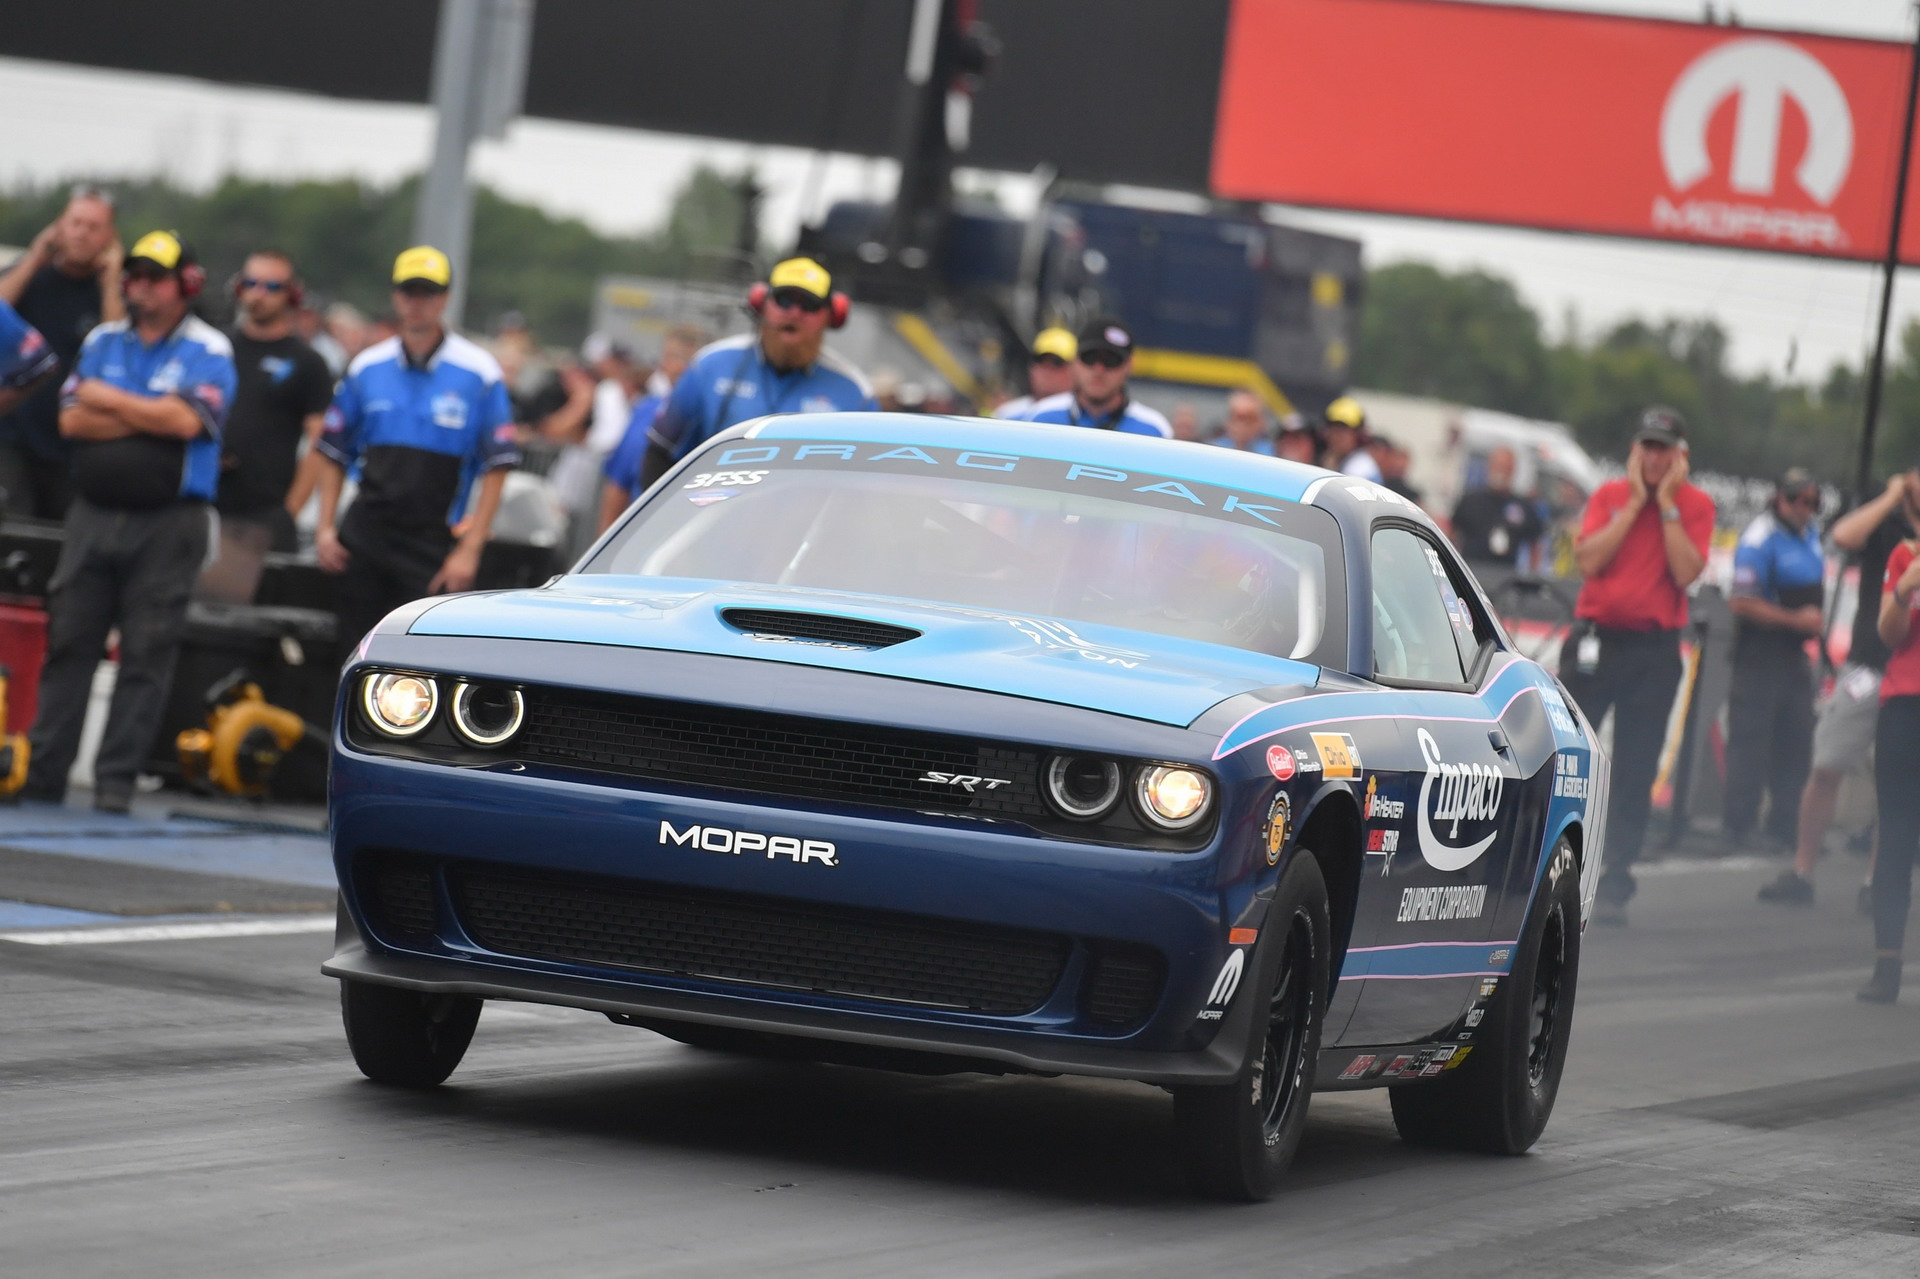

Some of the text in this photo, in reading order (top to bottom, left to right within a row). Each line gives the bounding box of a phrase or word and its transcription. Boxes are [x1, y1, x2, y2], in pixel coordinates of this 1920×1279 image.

[1652, 196, 1847, 250] MOPAR
[683, 470, 770, 490] 3FSS
[716, 444, 1283, 527] DRAG PAK
[918, 771, 1012, 792] SRT
[1417, 727, 1504, 871] Empaco
[659, 820, 837, 867] MOPAR
[1396, 884, 1488, 922] EQUIPMENT CORPORATION
